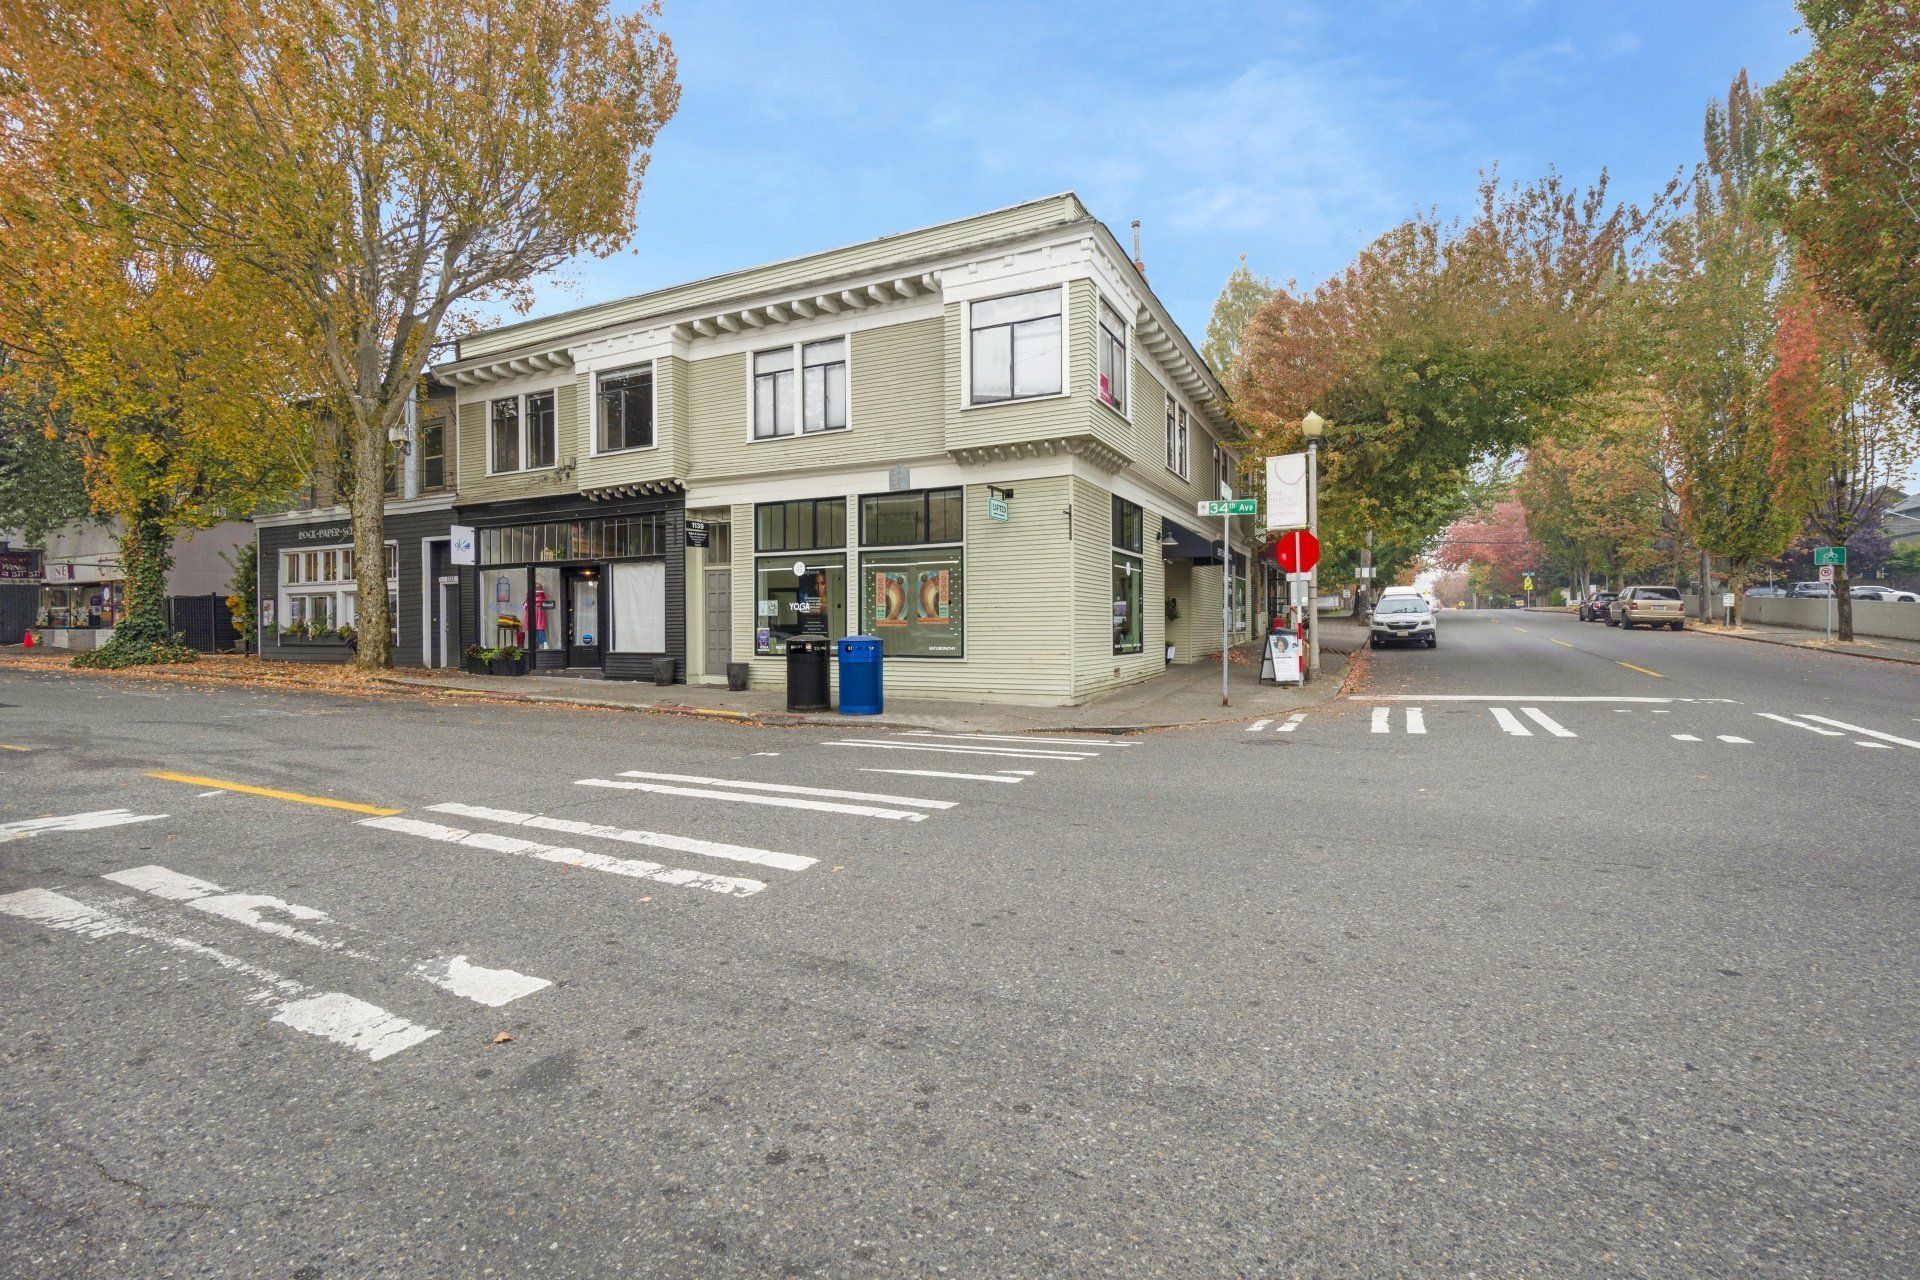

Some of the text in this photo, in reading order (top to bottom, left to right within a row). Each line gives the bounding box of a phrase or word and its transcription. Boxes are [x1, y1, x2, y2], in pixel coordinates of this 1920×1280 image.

[1210, 502, 1254, 514] 34th Ave
[789, 602, 811, 611] YOGA
